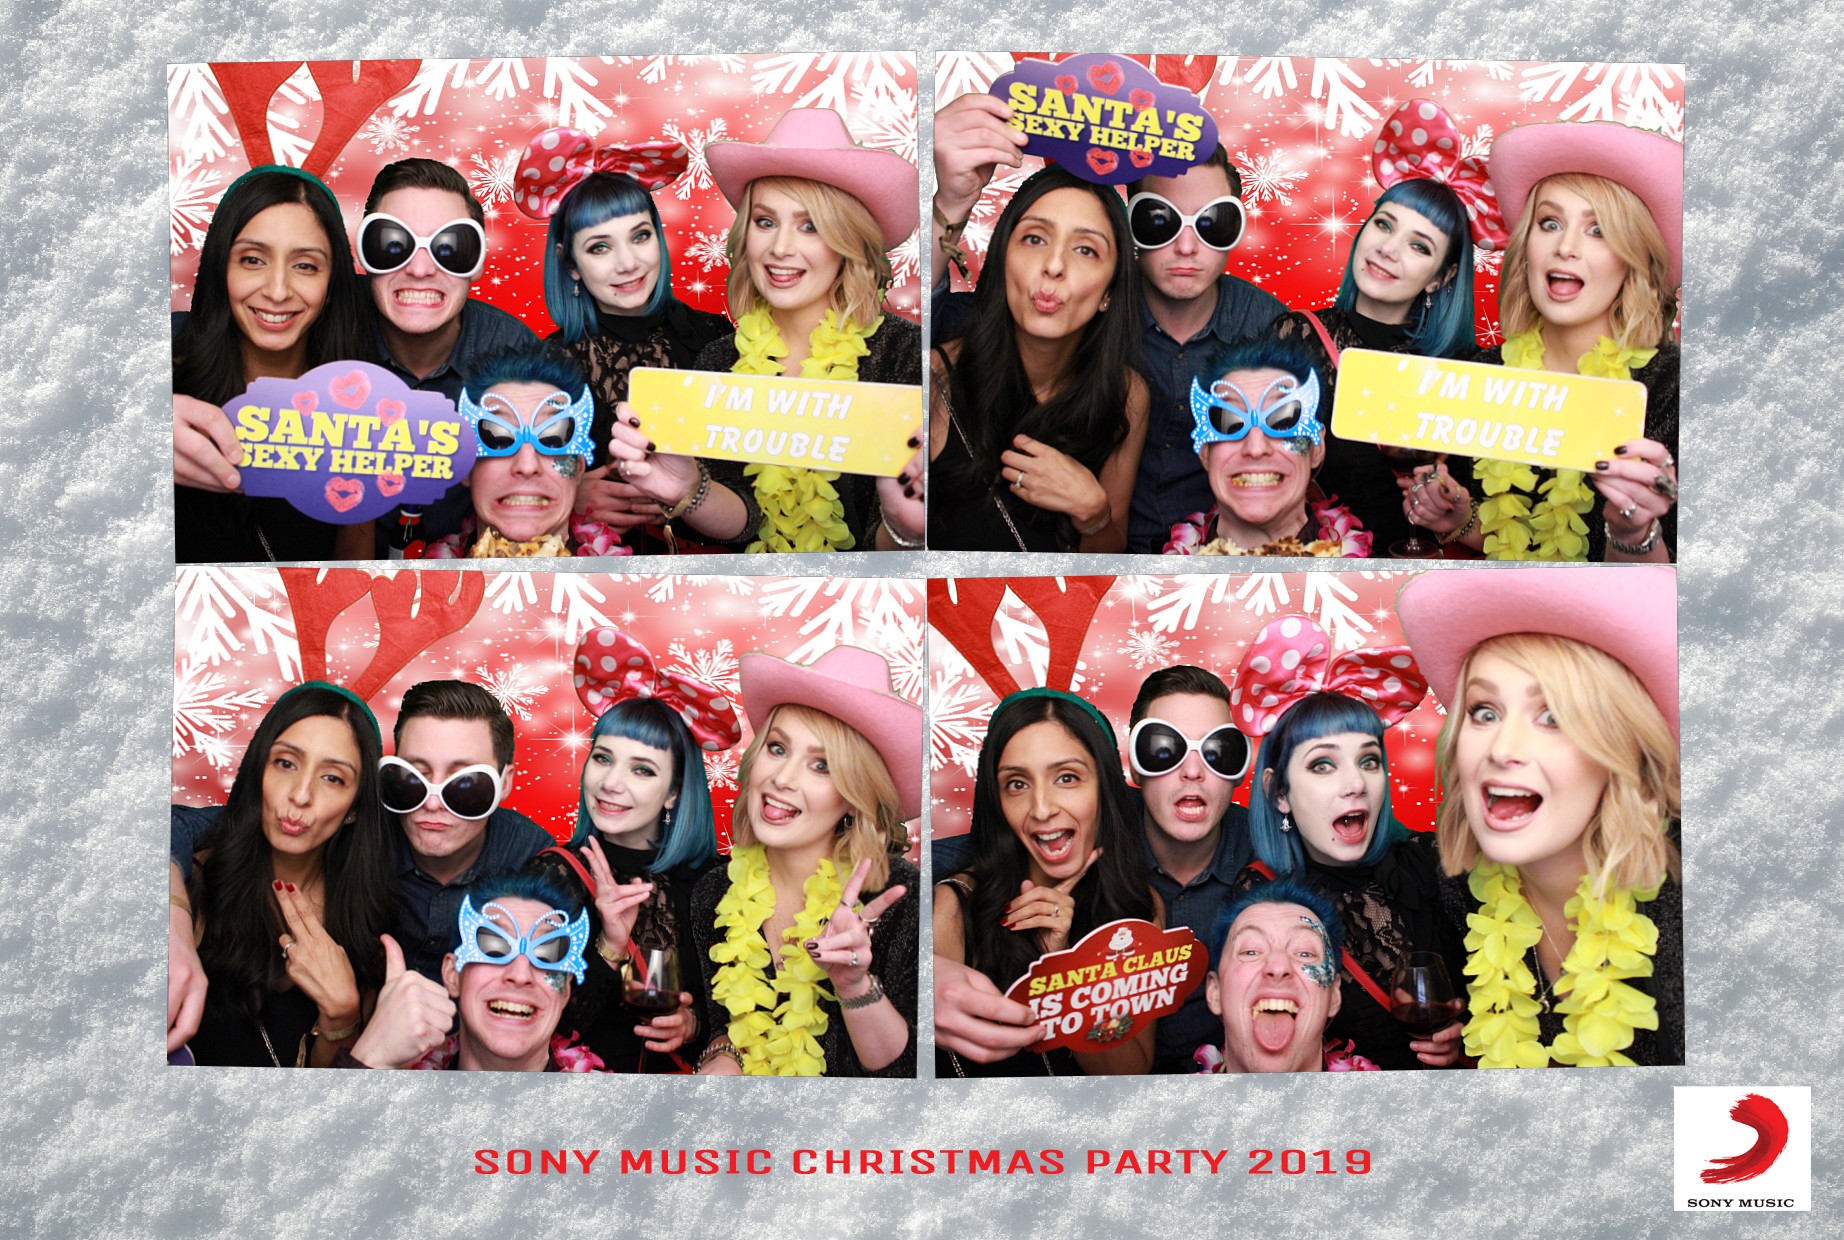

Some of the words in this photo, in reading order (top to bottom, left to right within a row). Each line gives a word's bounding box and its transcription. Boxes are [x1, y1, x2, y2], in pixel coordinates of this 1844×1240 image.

[1008, 82, 1204, 141] SANTA'S
[1008, 112, 1085, 141] SEXY
[1089, 125, 1196, 162] HELPER
[704, 384, 755, 412] I'M
[768, 388, 853, 420] WITH
[1417, 369, 1471, 400] I'M
[1483, 376, 1569, 412] WITH
[236, 405, 460, 456] SANTA'S
[706, 424, 850, 462] TROUBLE
[1416, 412, 1564, 456] TROUBLE
[238, 442, 324, 471] SEXY
[329, 449, 454, 480] HELPER
[1028, 960, 1117, 996] SANTA
[1122, 944, 1192, 974] CLAUS
[1028, 992, 1063, 1020] IS
[1070, 962, 1188, 1010] COMING
[1040, 1011, 1083, 1041] TO
[1091, 986, 1176, 1029] TOWN
